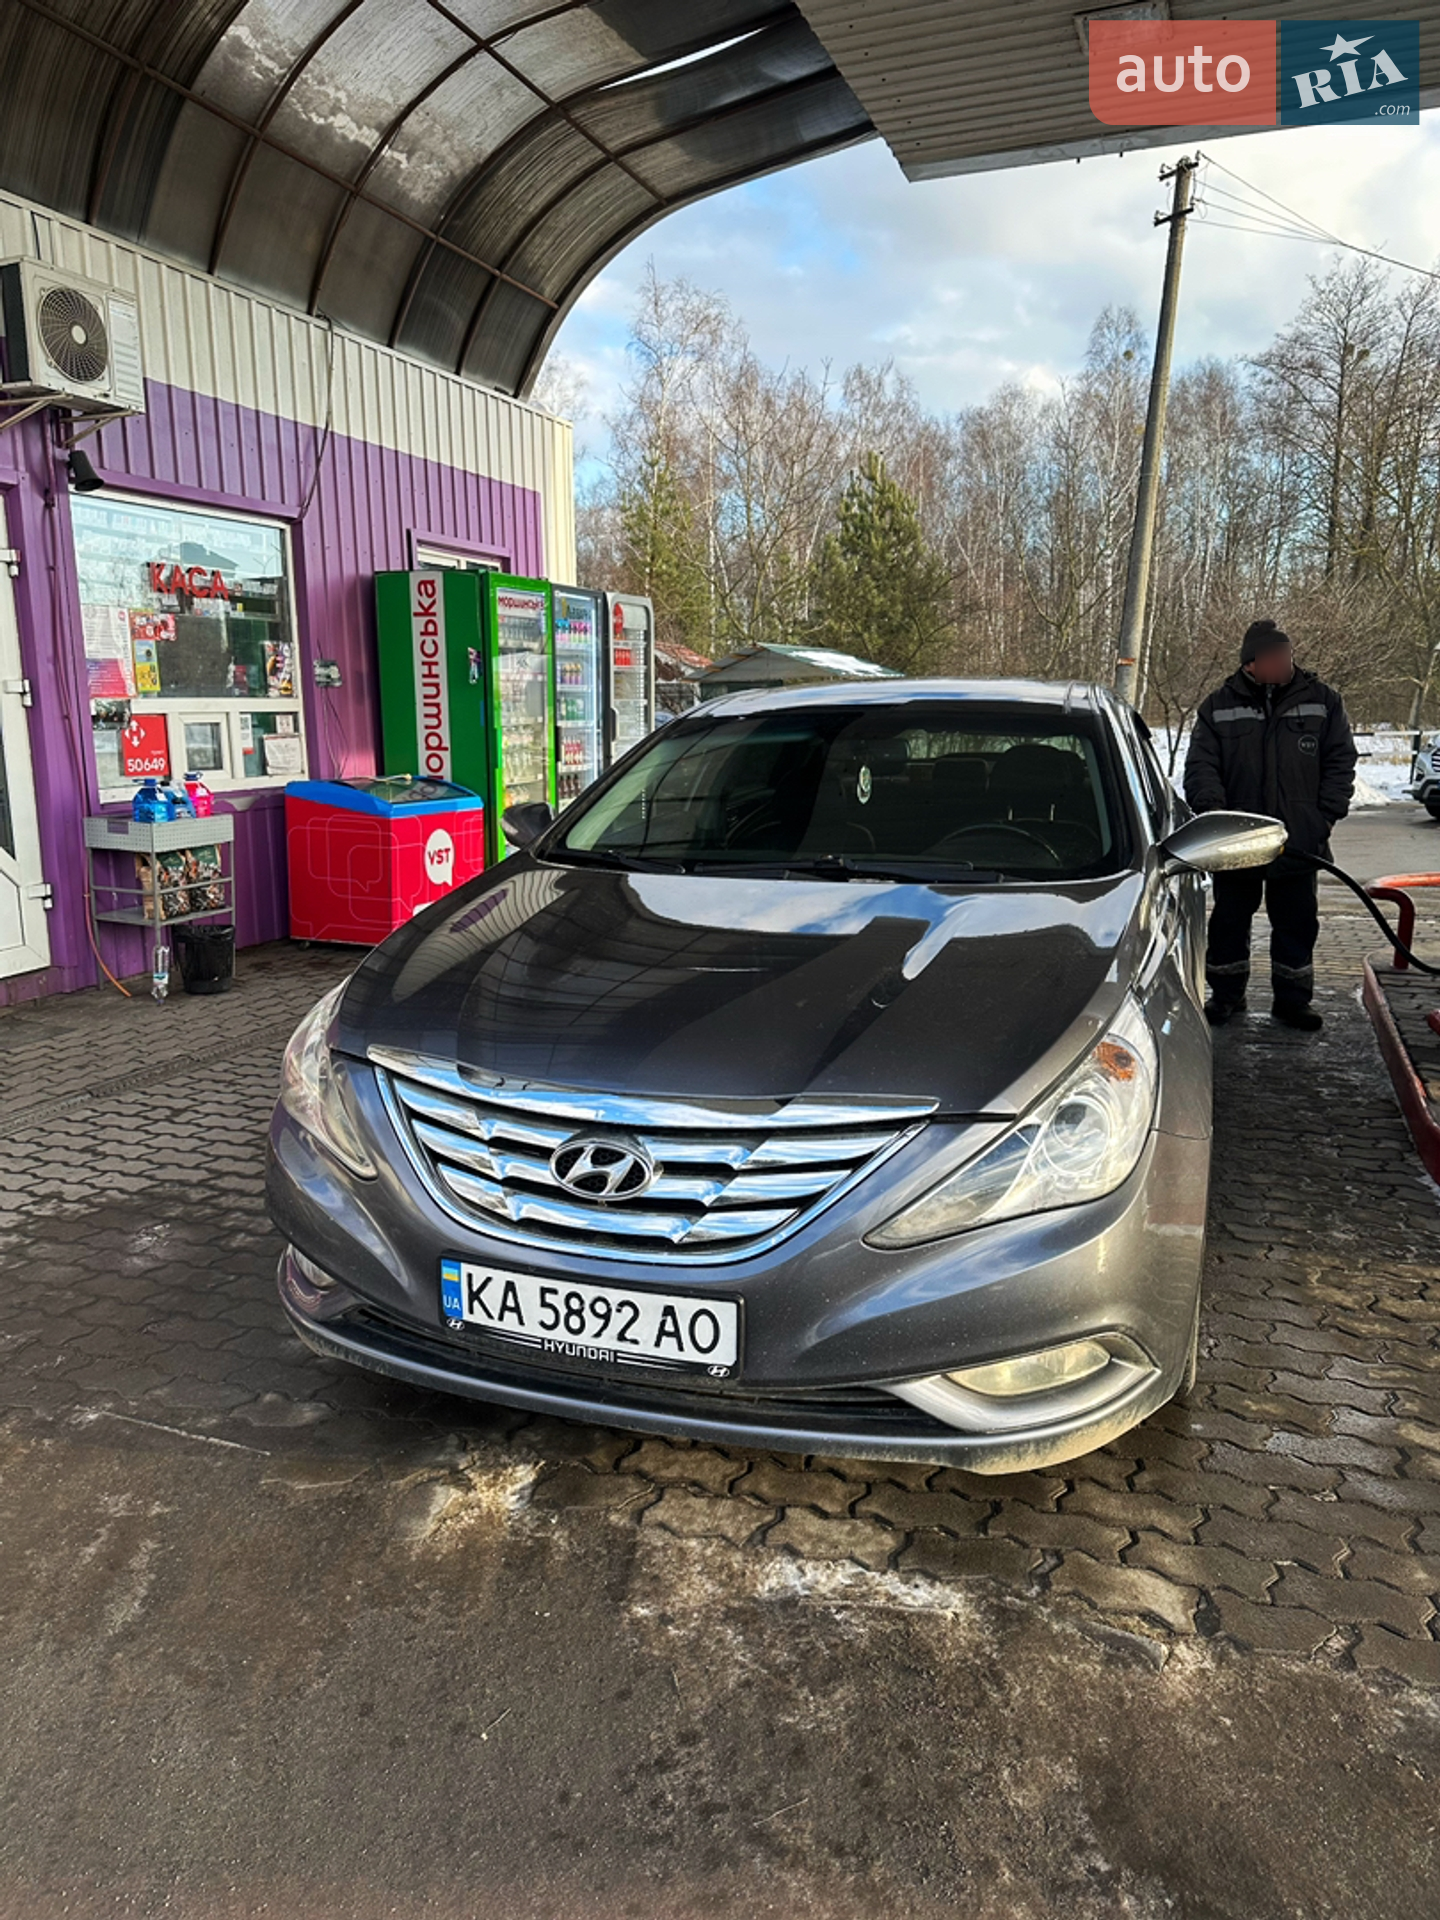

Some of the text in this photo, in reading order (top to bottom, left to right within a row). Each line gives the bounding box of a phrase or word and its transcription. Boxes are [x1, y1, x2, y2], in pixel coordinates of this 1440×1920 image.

[150, 562, 229, 602] КАСА
[127, 757, 165, 773] 50649
[428, 848, 451, 866] VST
[443, 1294, 461, 1311] UA
[466, 1272, 720, 1355] KA 5892 AO
[544, 1338, 615, 1363] HYUNDAI
